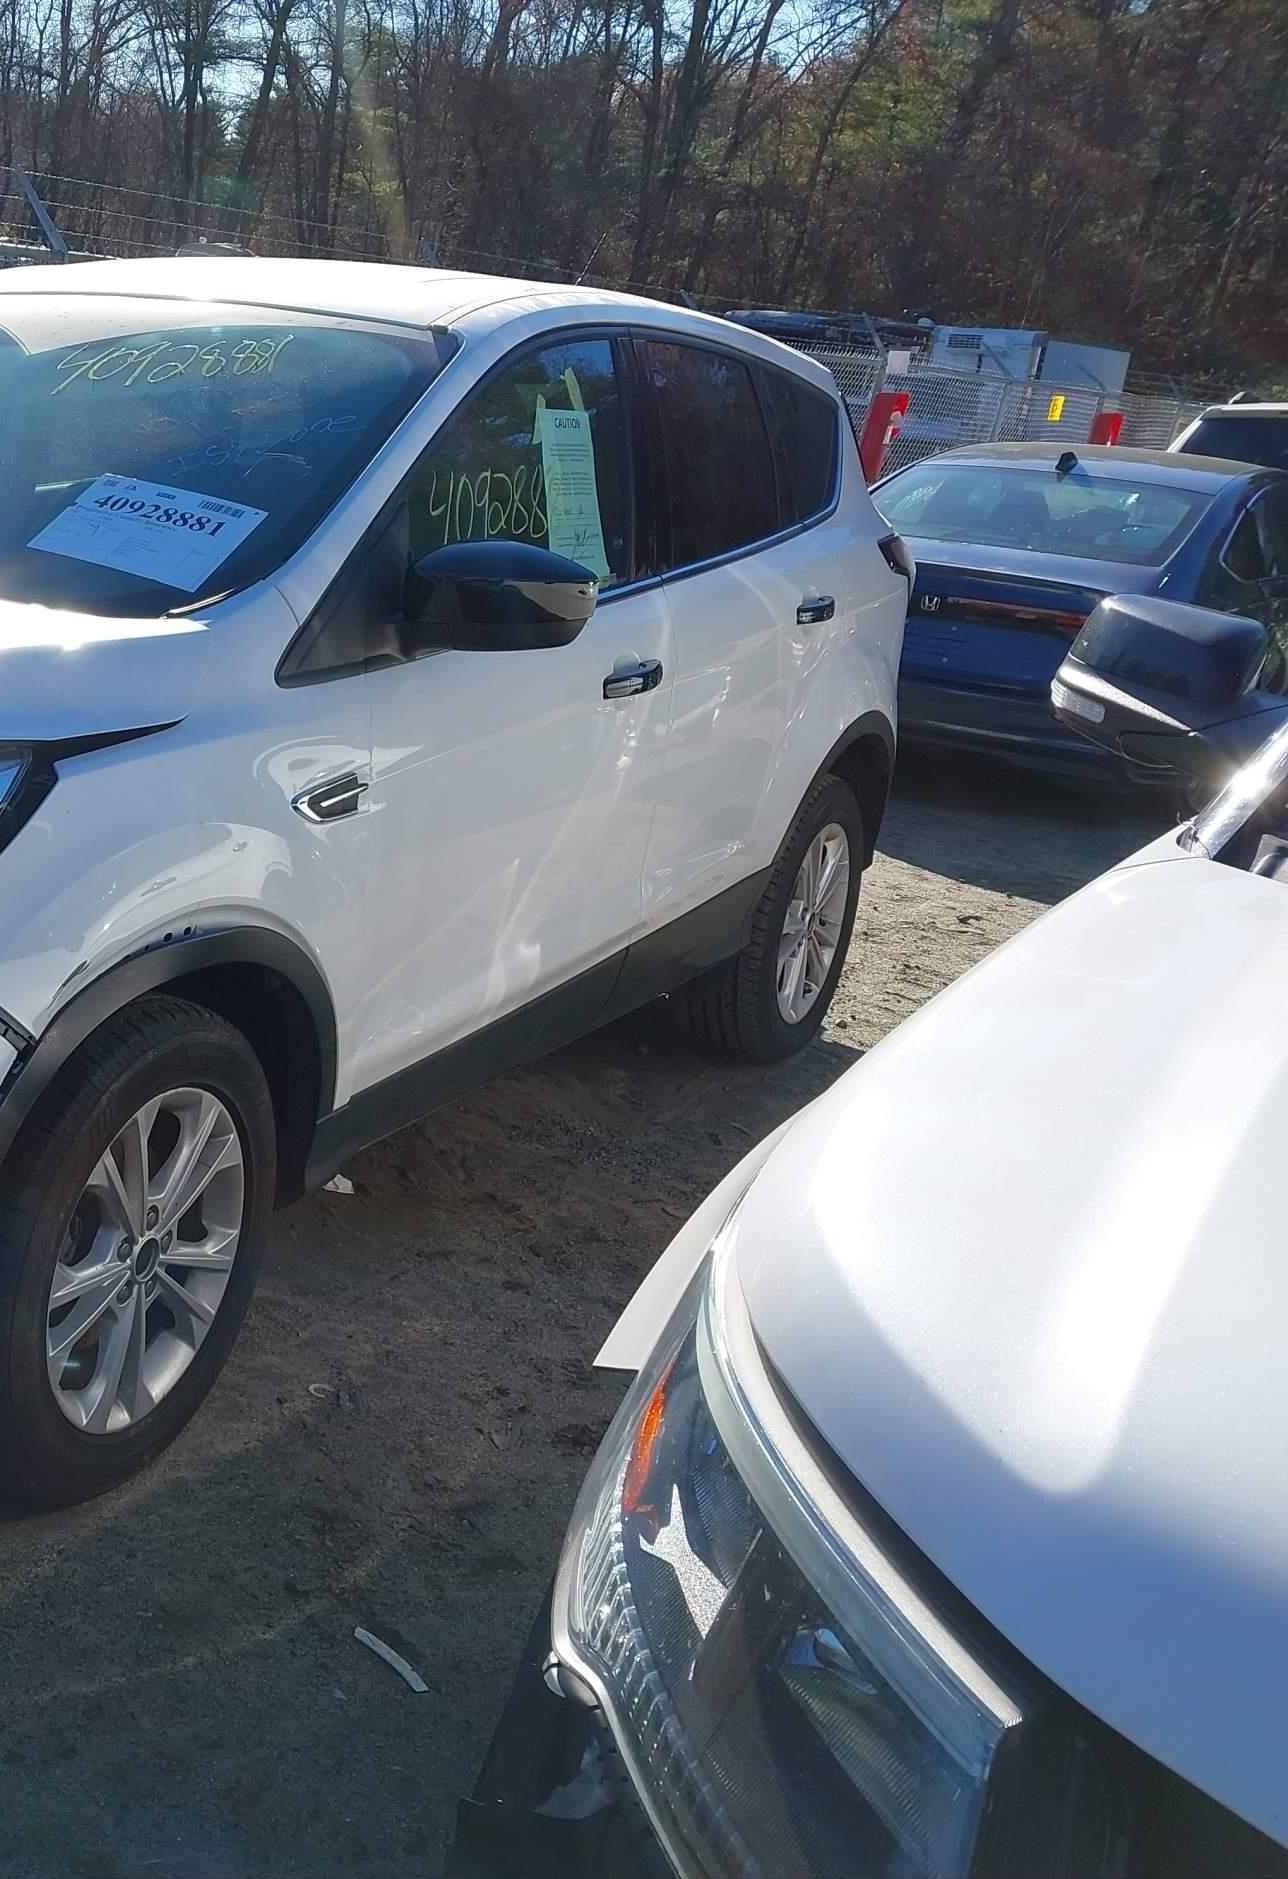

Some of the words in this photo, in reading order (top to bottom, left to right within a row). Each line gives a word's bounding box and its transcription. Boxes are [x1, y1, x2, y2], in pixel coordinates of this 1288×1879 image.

[49, 334, 295, 395] 40928881
[554, 417, 581, 429] CAUTION
[93, 493, 227, 537] 40928881
